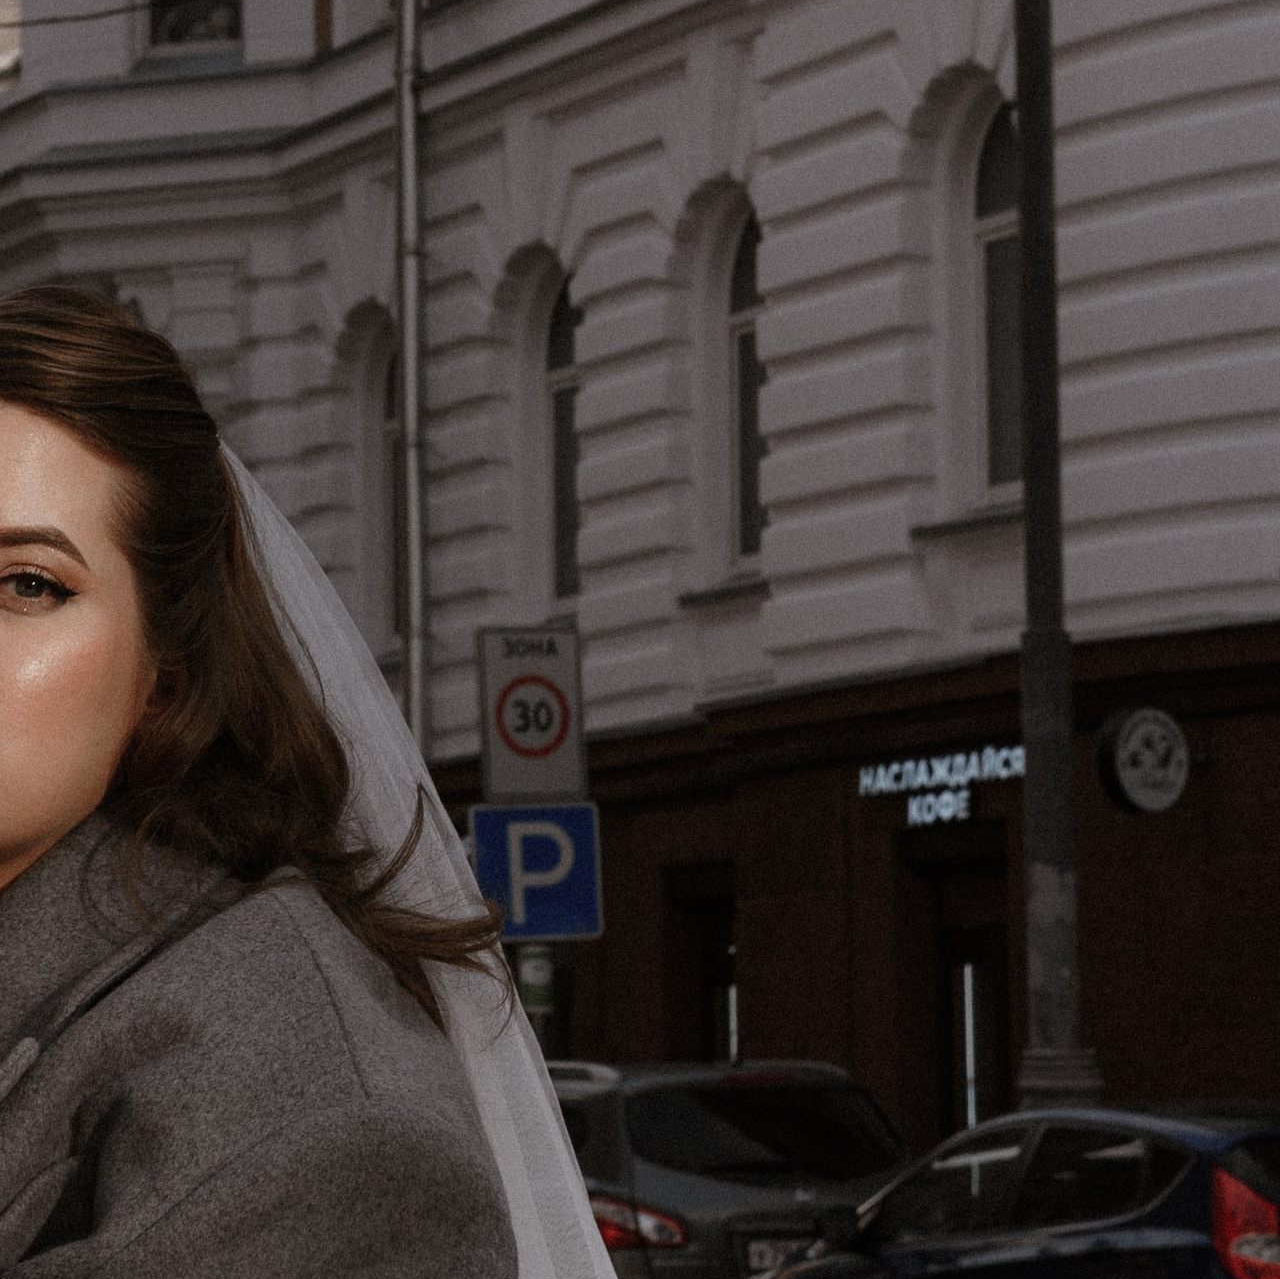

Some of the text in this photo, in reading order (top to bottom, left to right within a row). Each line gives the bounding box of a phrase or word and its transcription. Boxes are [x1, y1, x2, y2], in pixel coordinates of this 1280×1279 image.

[501, 635, 560, 659] ЗОНА
[512, 698, 554, 734] 30
[907, 789, 970, 826] КОФЕ
[507, 823, 576, 925] P
